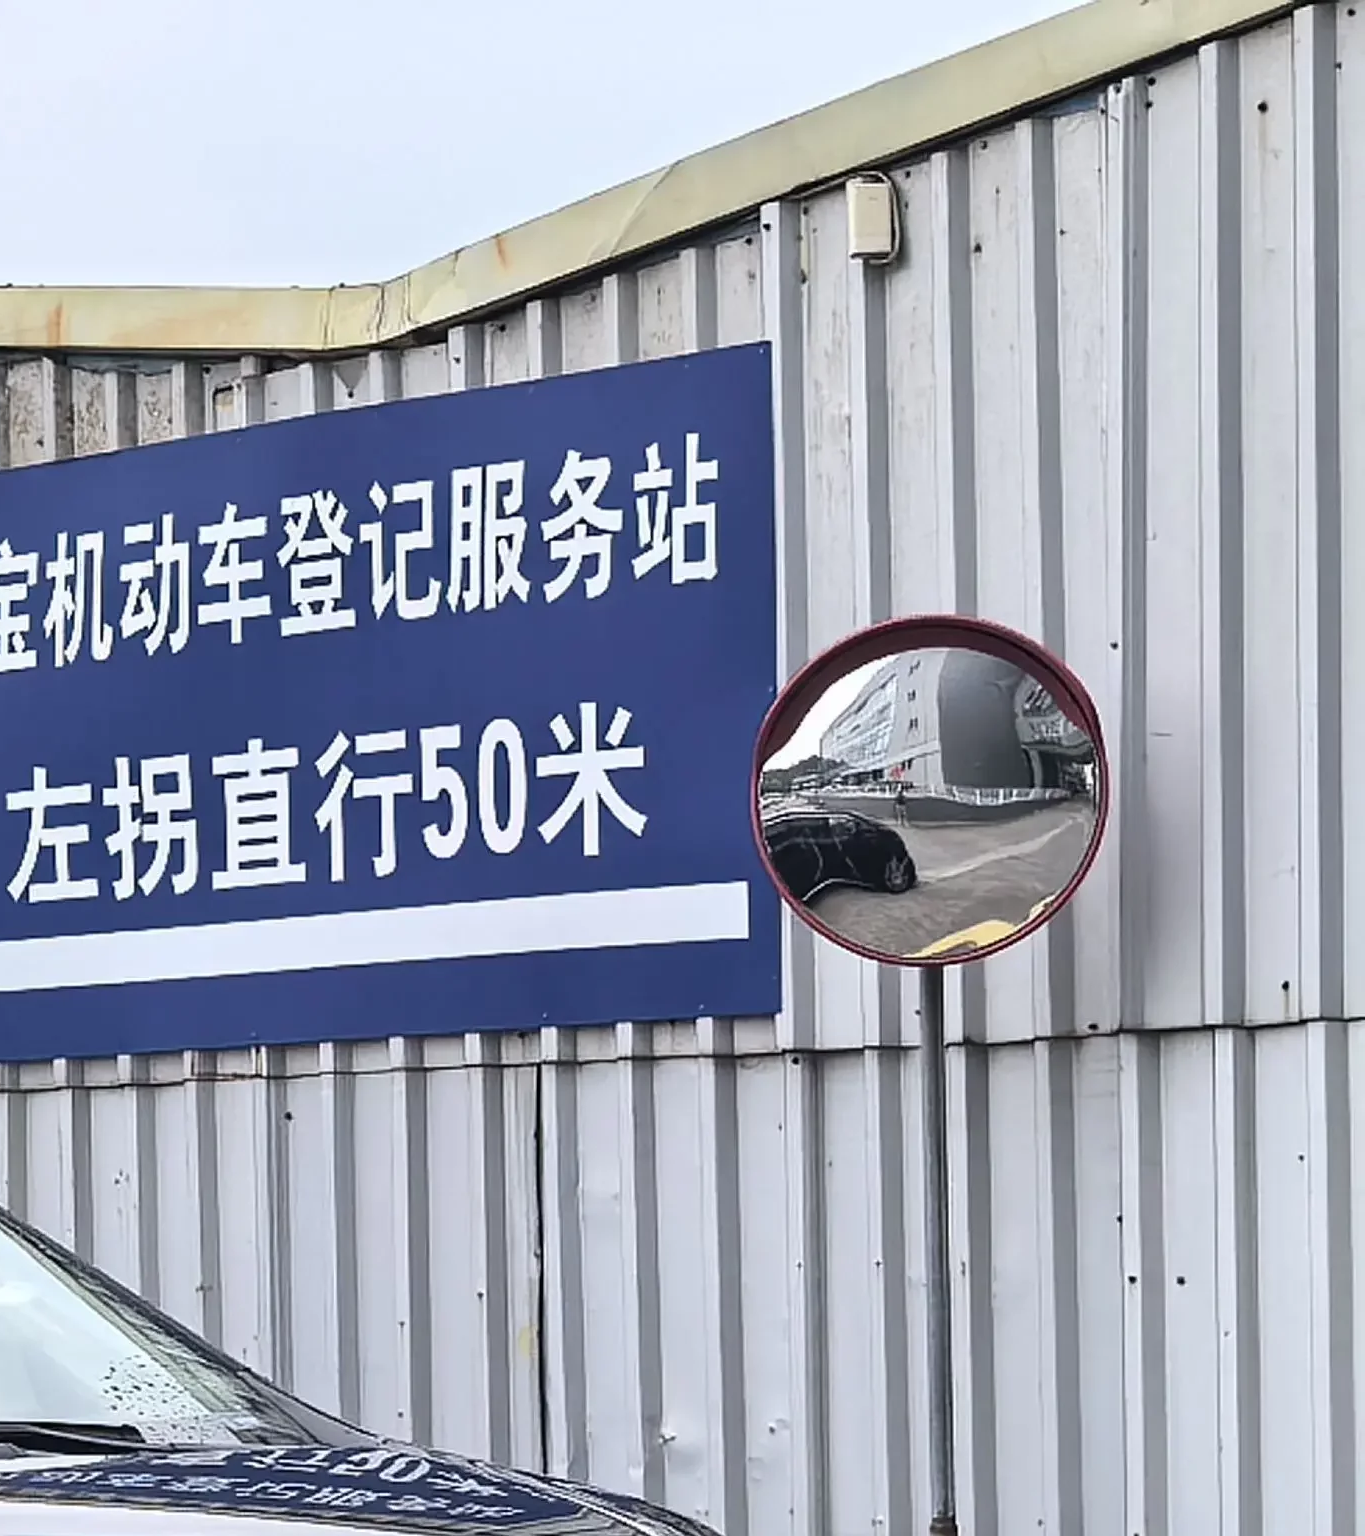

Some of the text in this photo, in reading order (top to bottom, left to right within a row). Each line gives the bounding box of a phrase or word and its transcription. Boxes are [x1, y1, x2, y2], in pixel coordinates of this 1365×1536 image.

[6, 701, 647, 903] 左拐直行50米
